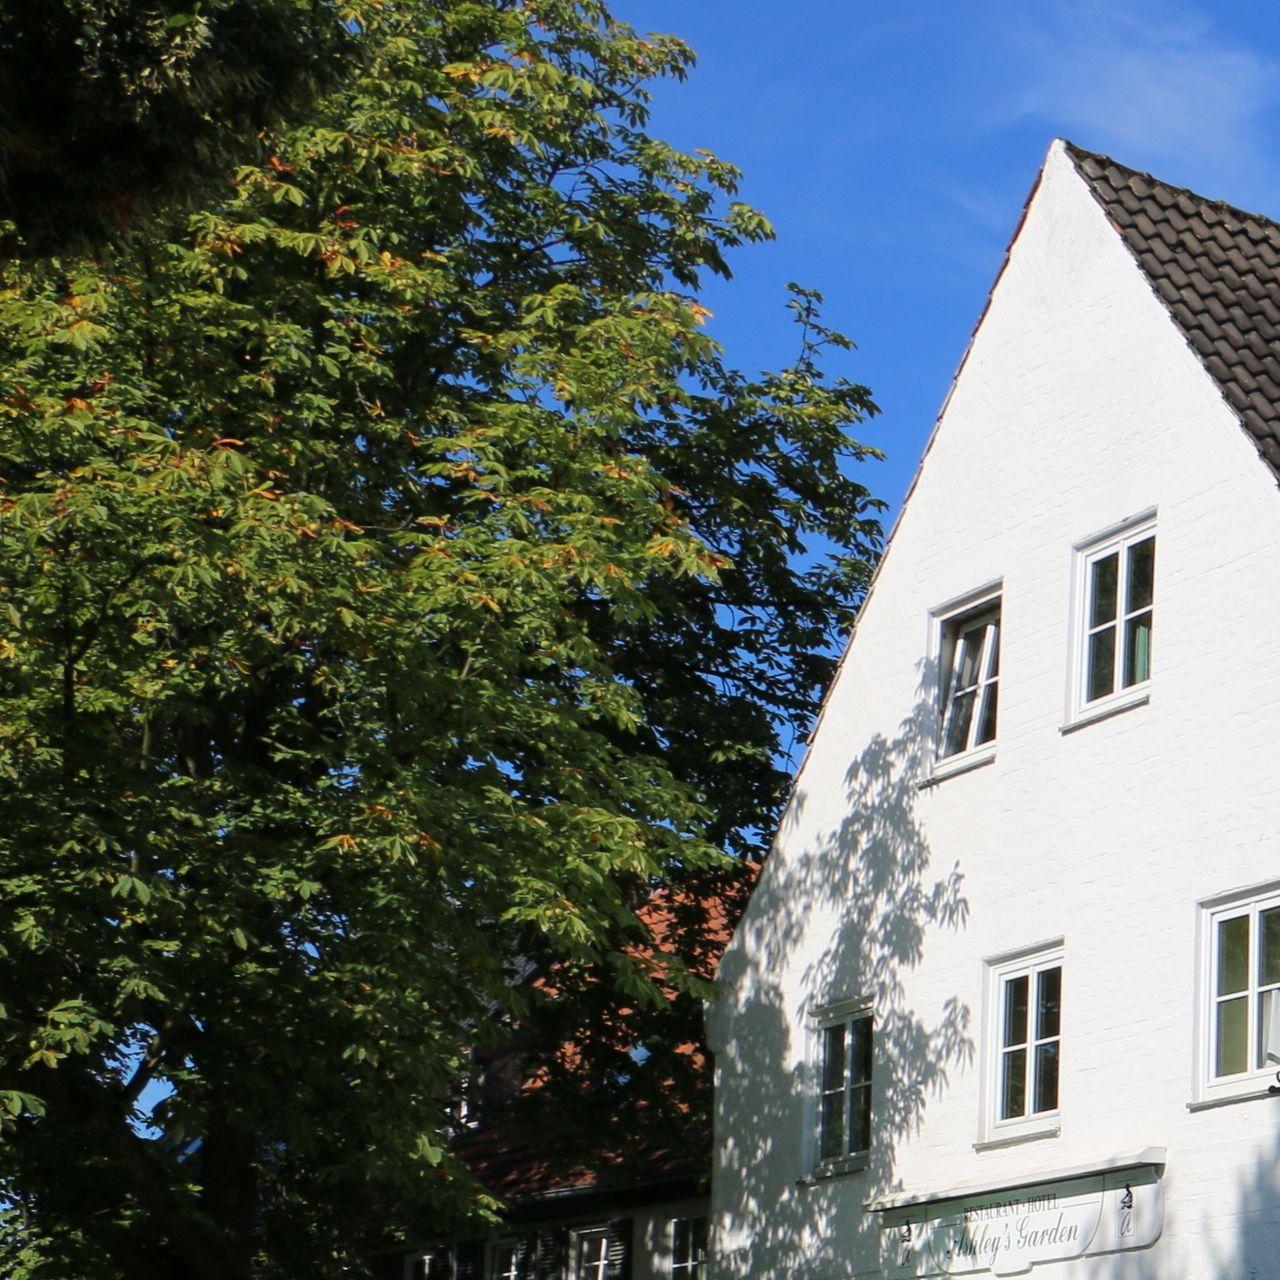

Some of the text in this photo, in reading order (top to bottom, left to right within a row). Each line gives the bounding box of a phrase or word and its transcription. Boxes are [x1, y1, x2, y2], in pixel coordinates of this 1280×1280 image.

[963, 1193, 1060, 1224] RESTAURANT HOTEL
[1016, 1212, 1079, 1249] Garden
